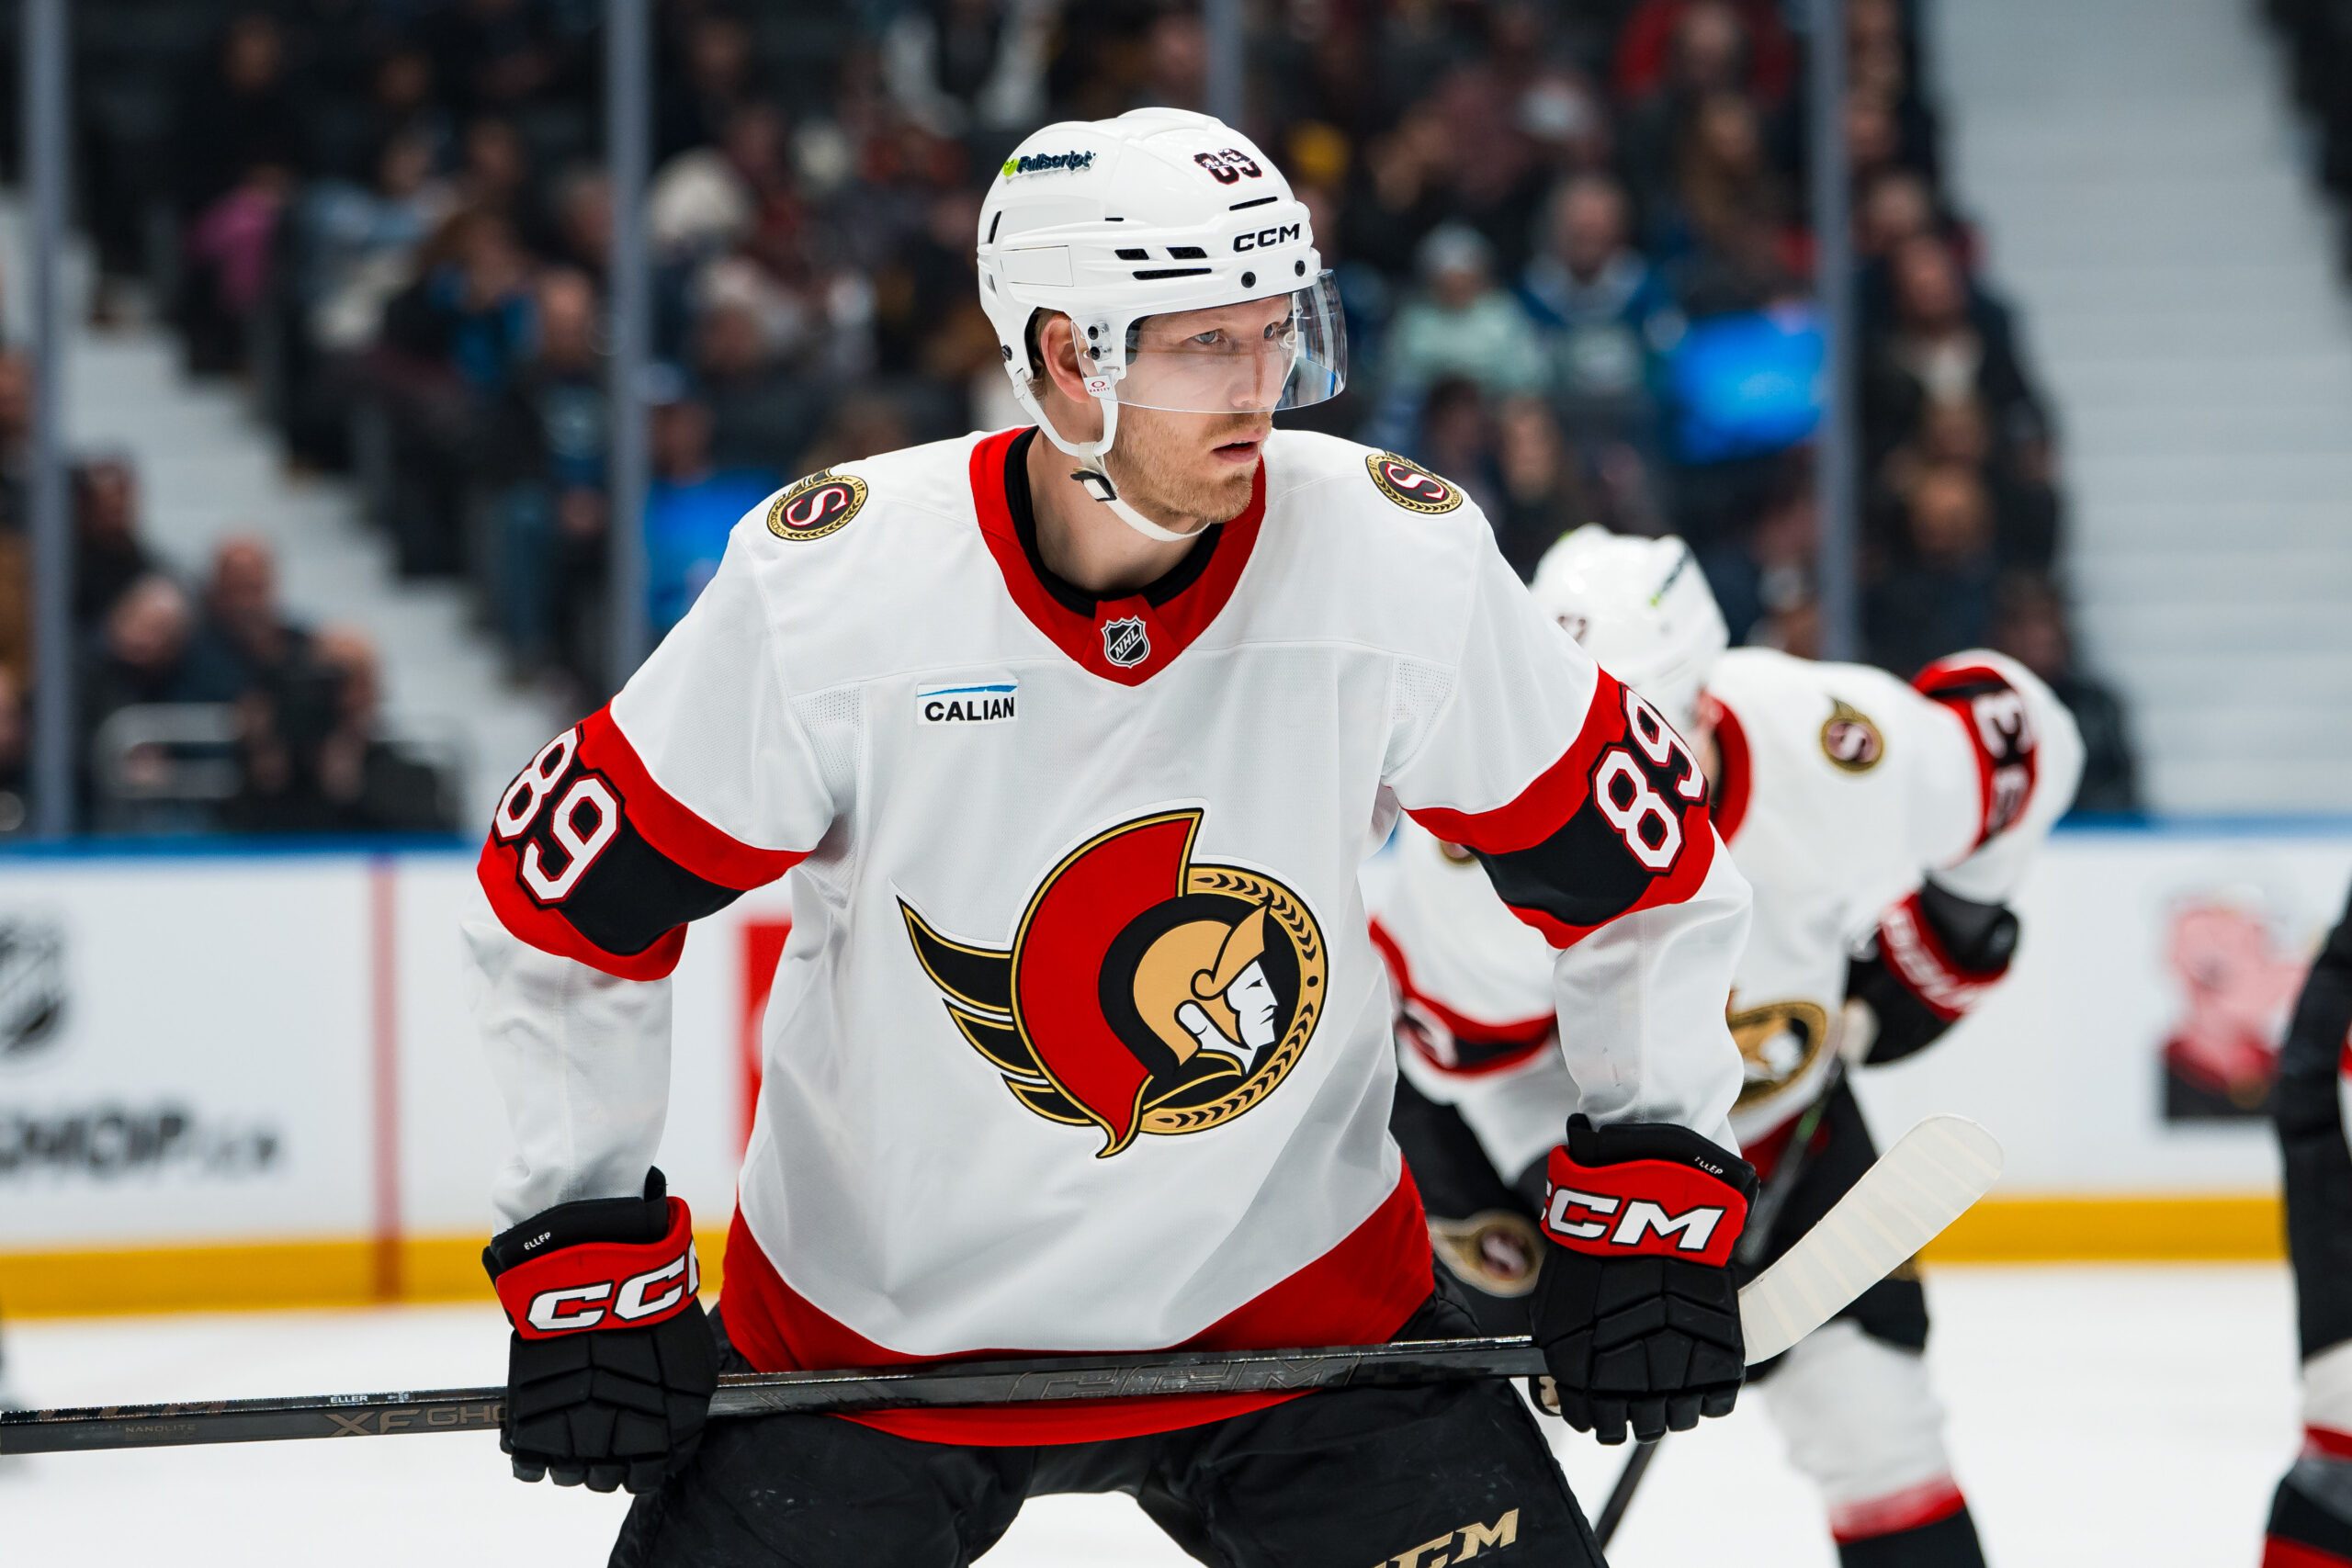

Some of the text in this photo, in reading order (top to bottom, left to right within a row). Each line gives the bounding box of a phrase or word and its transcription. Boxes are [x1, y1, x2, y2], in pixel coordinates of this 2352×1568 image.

[1016, 151, 1091, 174] Fullscript
[1233, 223, 1300, 253] CCM
[1114, 626, 1140, 659] NHL
[924, 696, 1014, 721] CALIAN
[1593, 686, 1705, 871] 89
[494, 726, 620, 902] 89
[1541, 1180, 1724, 1250] CM
[331, 1395, 368, 1404] ELLER
[324, 1408, 422, 1437] XF
[1371, 1507, 1519, 1568] CM
